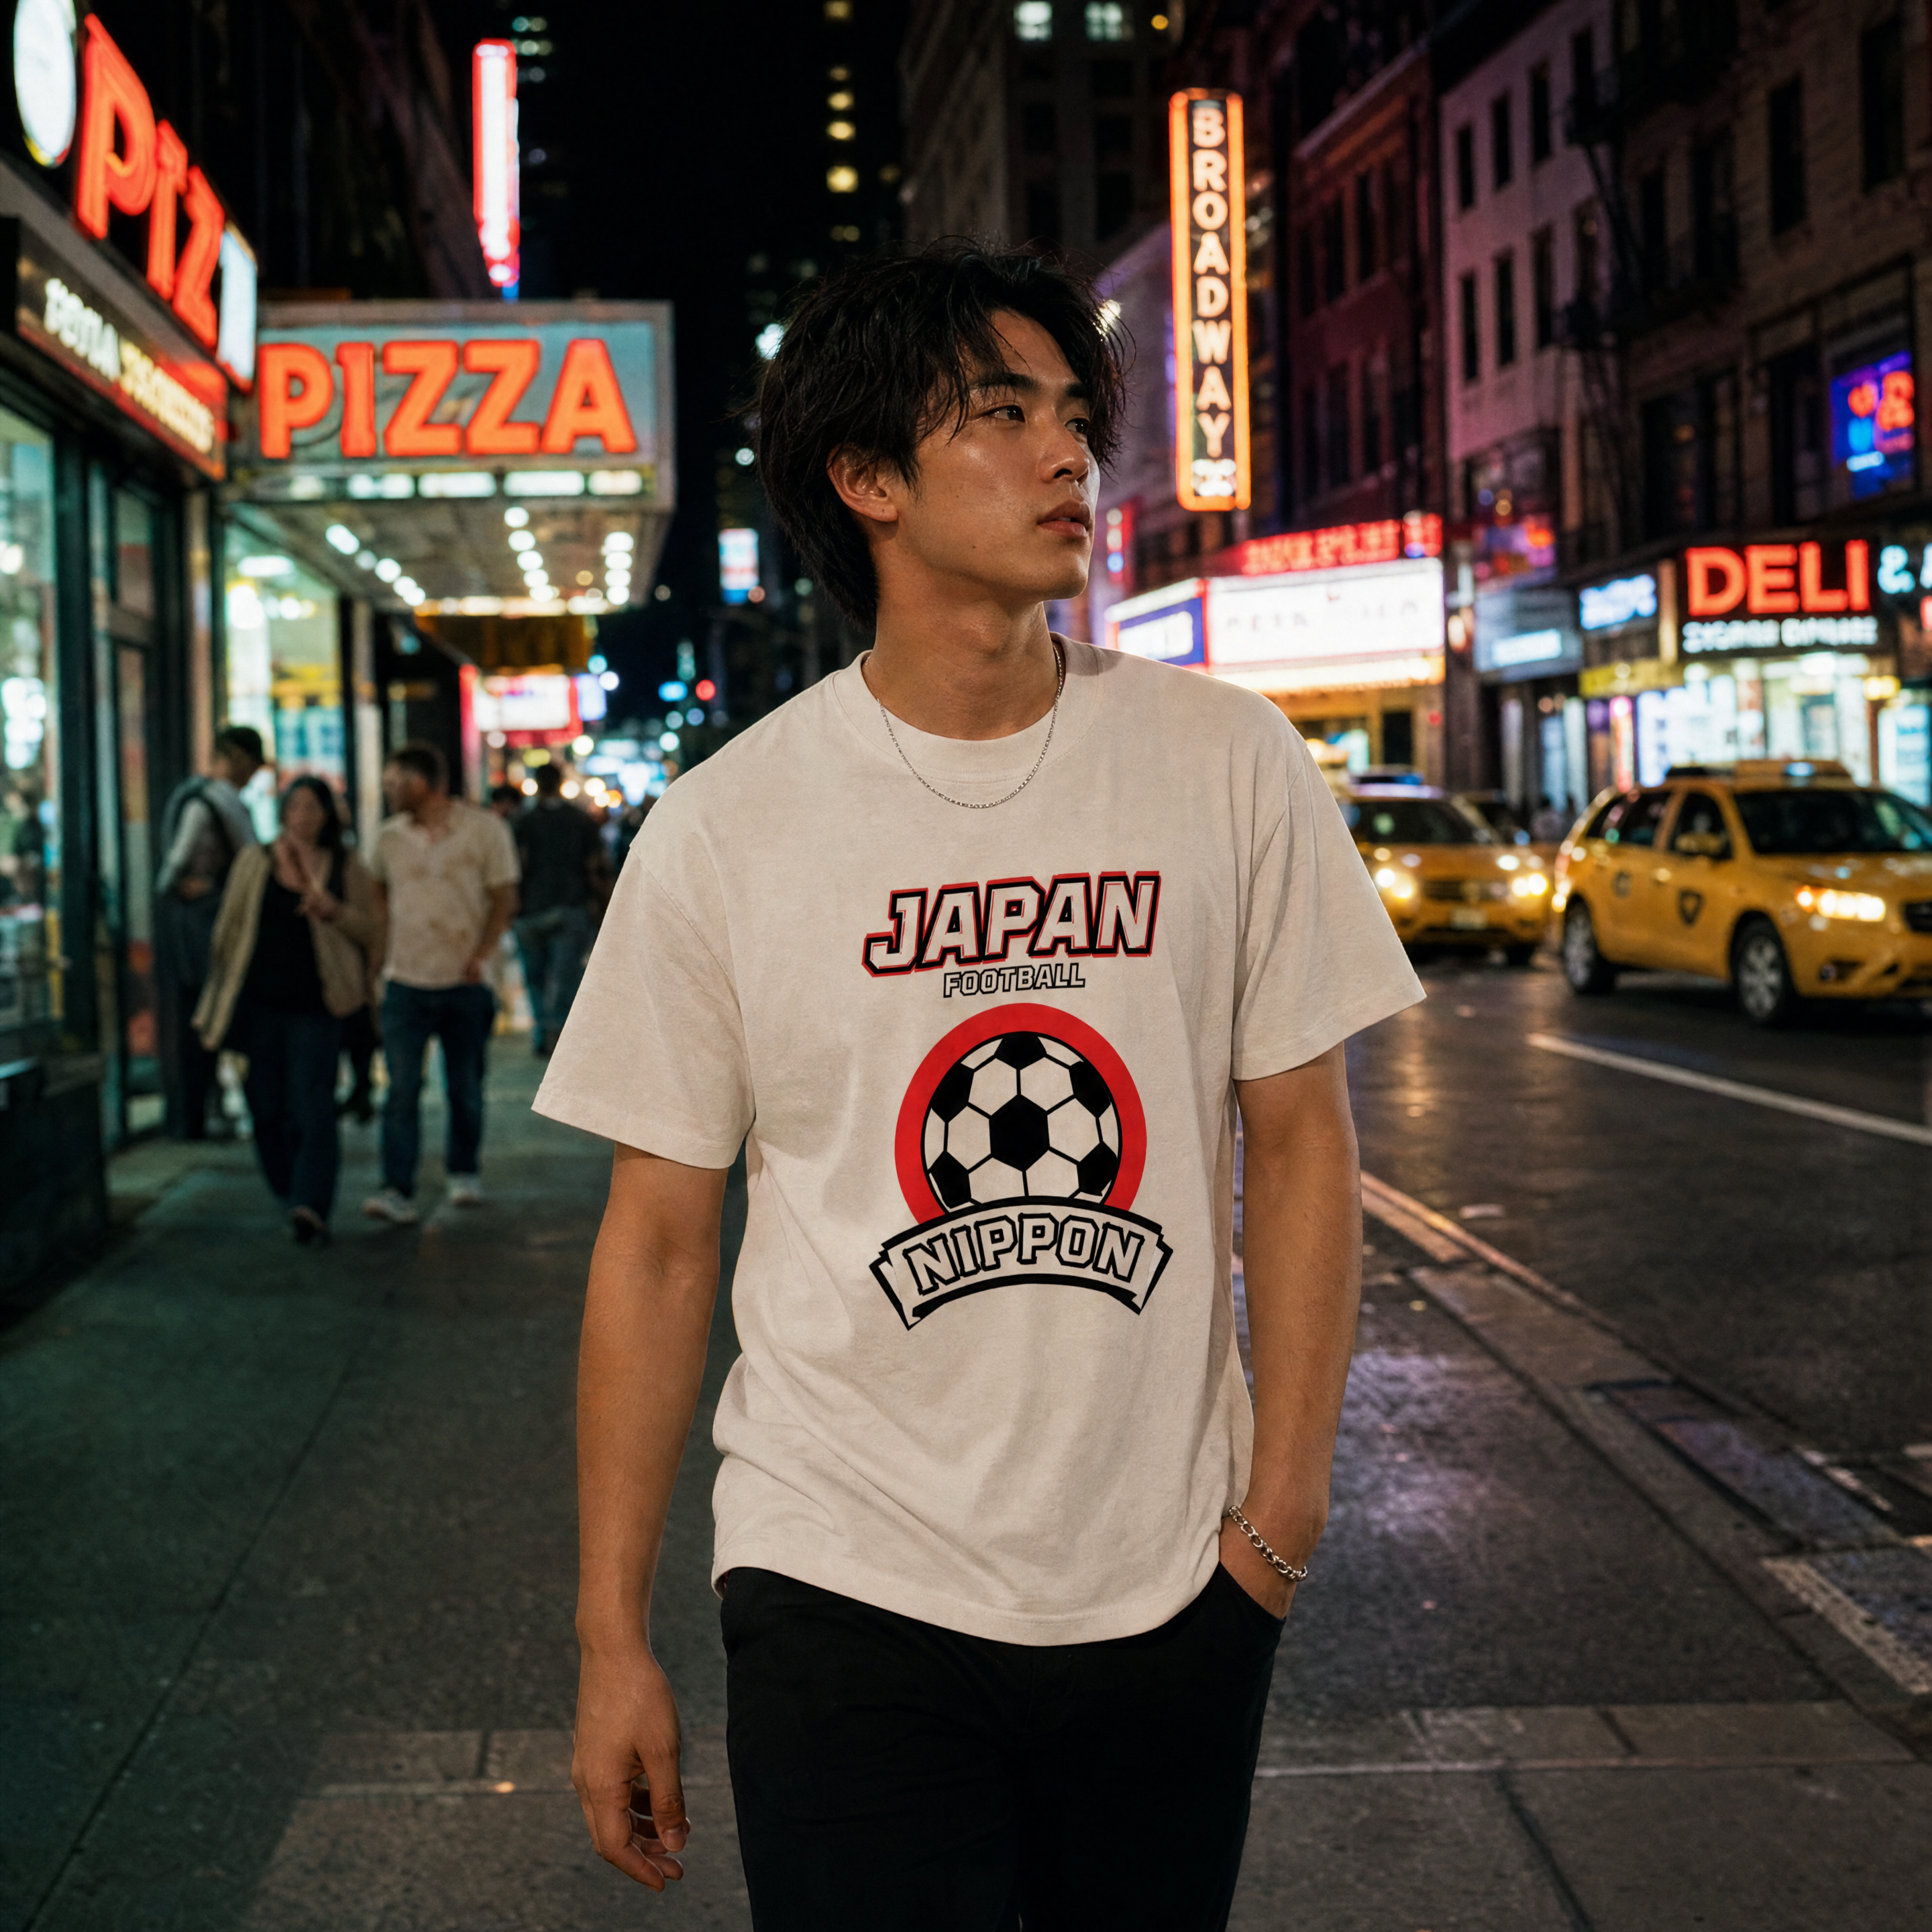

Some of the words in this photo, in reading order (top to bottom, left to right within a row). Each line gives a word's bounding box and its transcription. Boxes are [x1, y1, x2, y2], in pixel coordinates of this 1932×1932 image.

[1191, 106, 1233, 459] BROADWAY
[258, 338, 638, 460] PIZZA
[1684, 538, 1871, 616] DELI
[1877, 544, 1916, 595] &
[861, 871, 1161, 977] JAPAN
[943, 963, 1085, 998] FOOTBALL
[902, 1213, 1144, 1296] NIPPON
